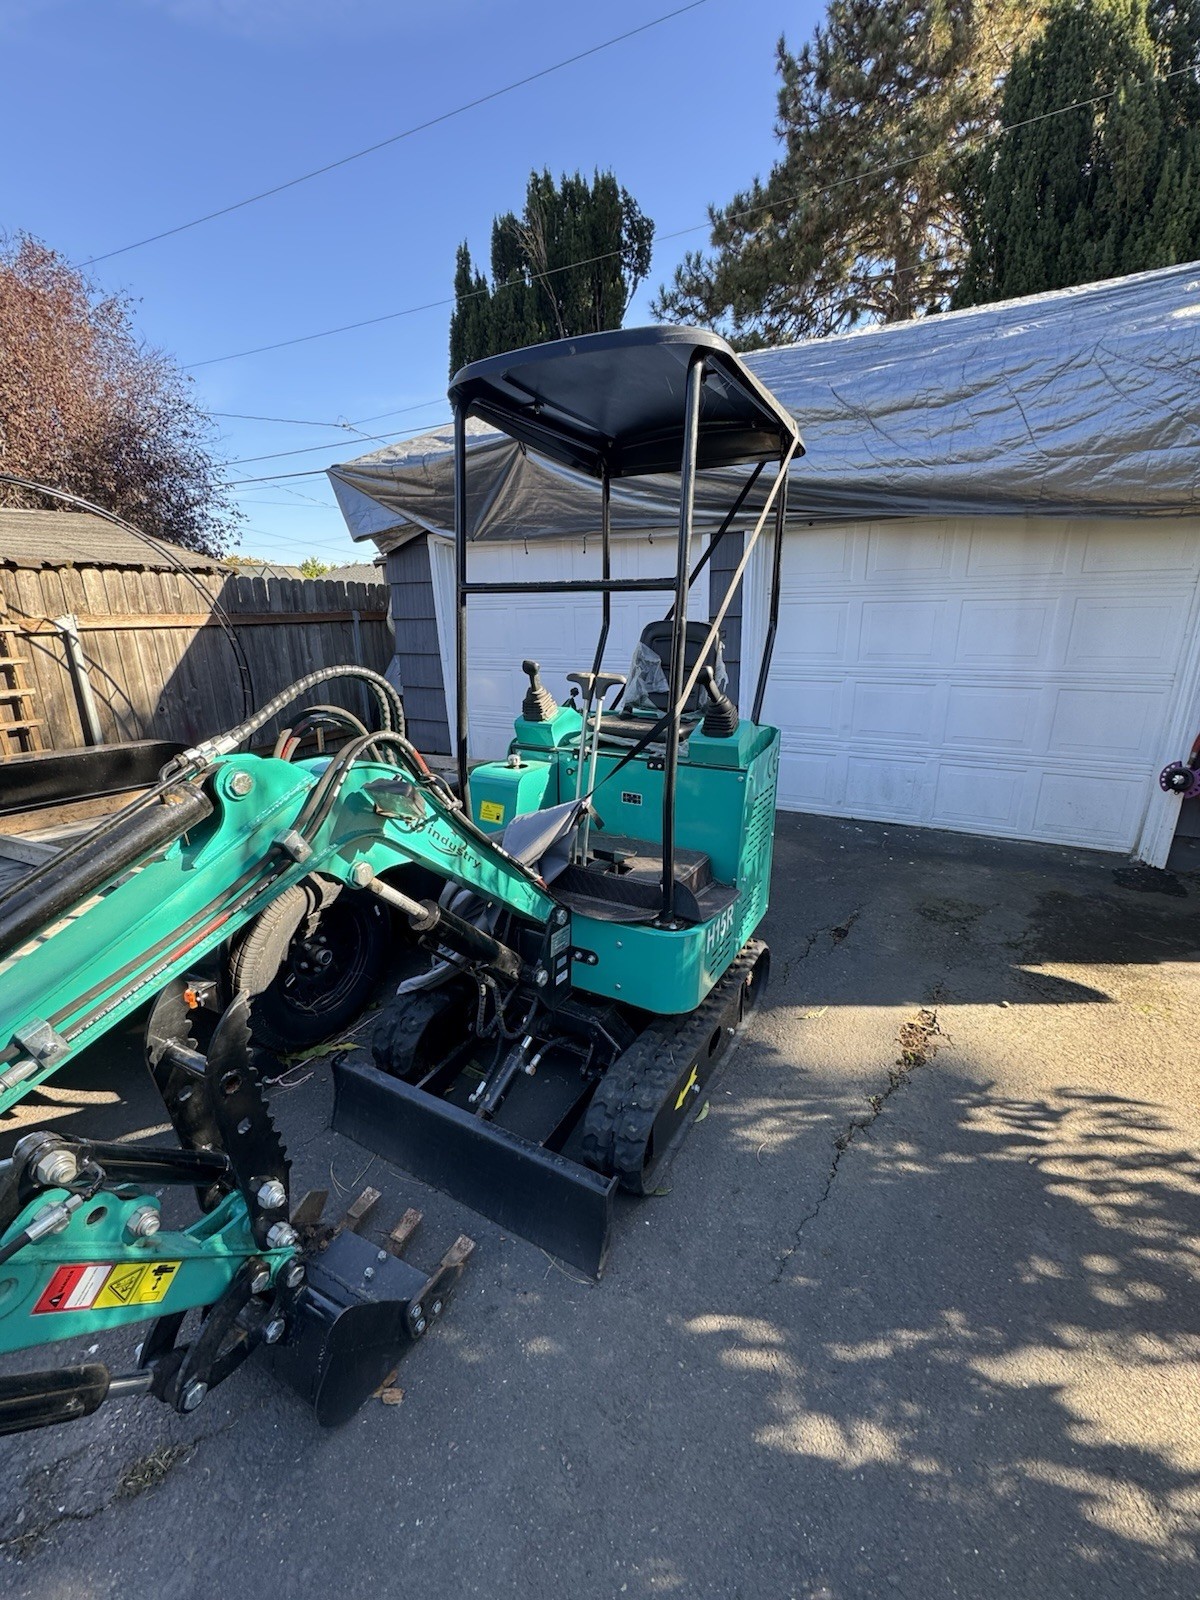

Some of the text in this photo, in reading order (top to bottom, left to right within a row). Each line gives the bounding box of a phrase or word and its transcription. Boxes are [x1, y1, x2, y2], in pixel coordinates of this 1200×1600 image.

[427, 824, 481, 868] industry
[706, 903, 734, 954] H15R
[58, 1270, 74, 1293] DANGER
